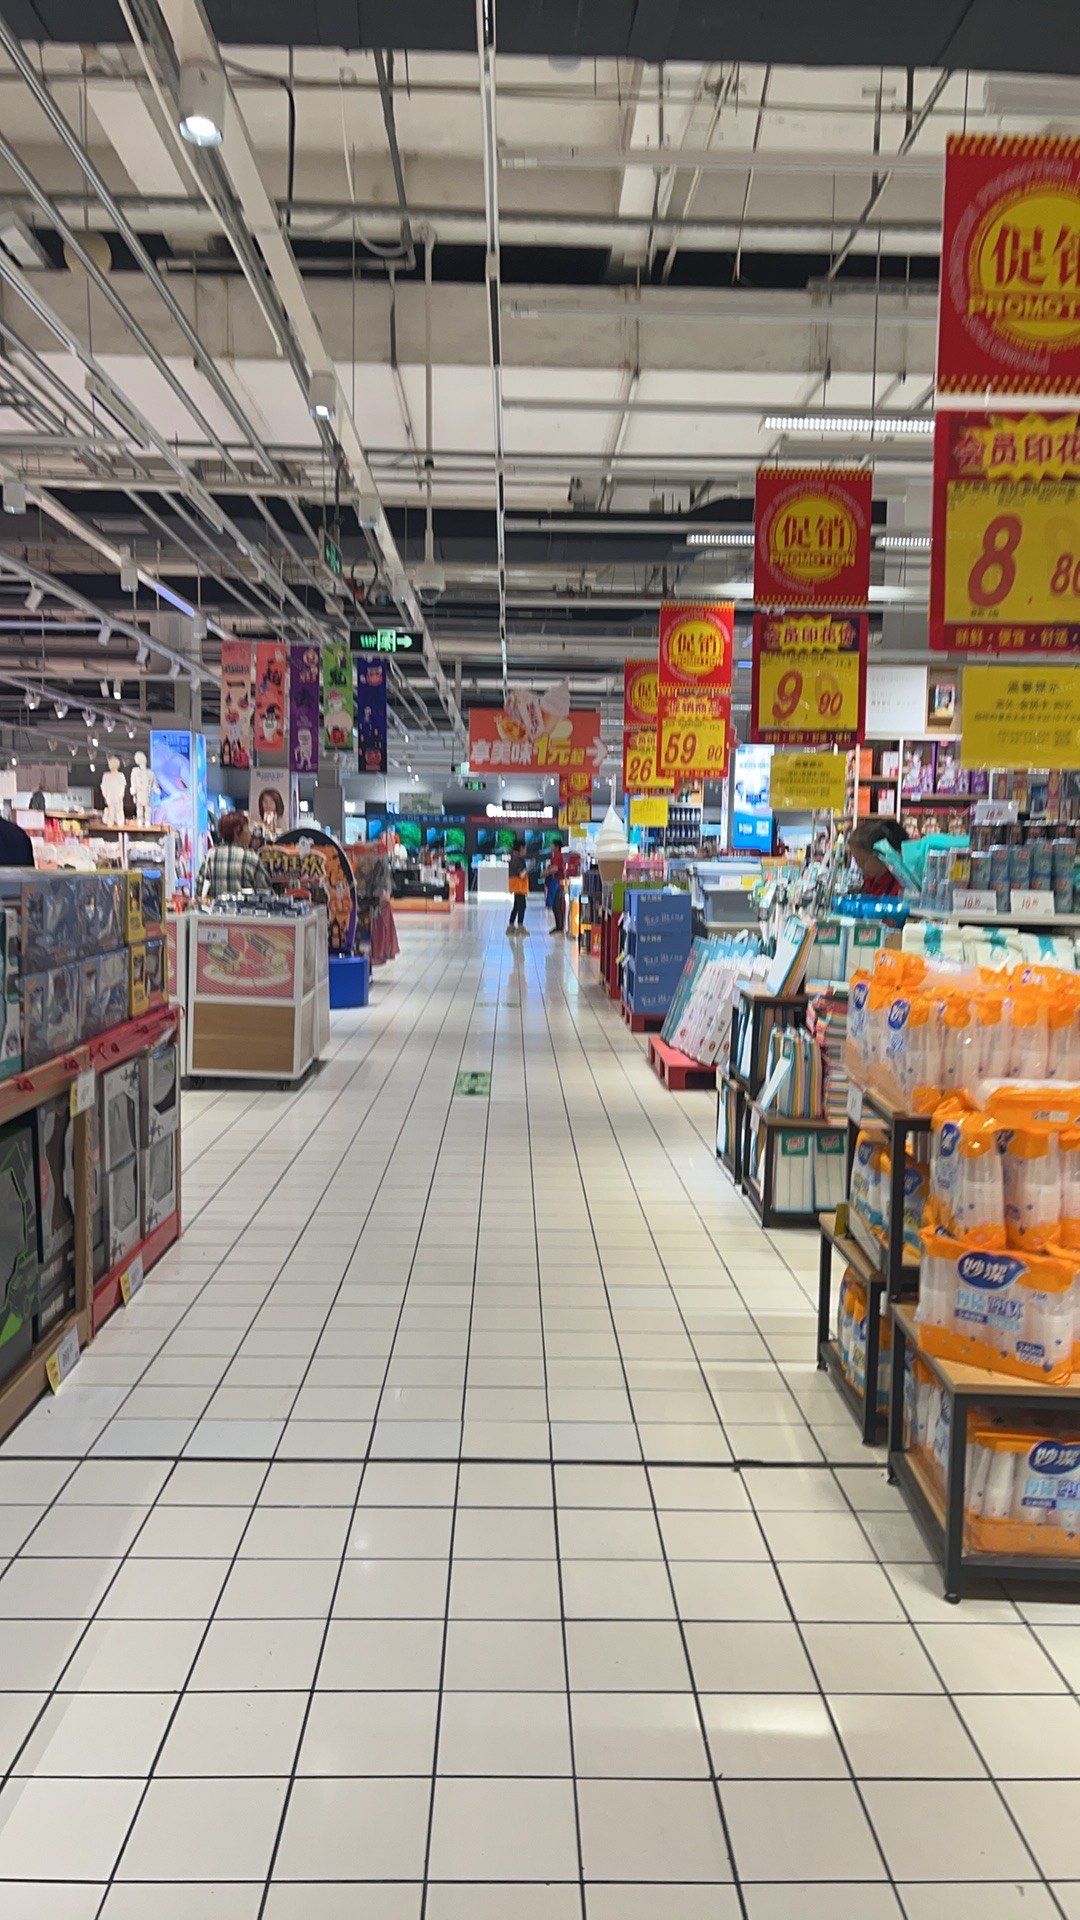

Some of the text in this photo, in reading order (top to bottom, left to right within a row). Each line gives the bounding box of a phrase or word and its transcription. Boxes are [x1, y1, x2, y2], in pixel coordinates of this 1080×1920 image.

[783, 514, 846, 550] 促销
[769, 551, 856, 567] PROMOTION
[968, 513, 1023, 608] 8
[677, 633, 718, 654] 促销
[772, 668, 803, 721] 9
[664, 731, 697, 765] 59
